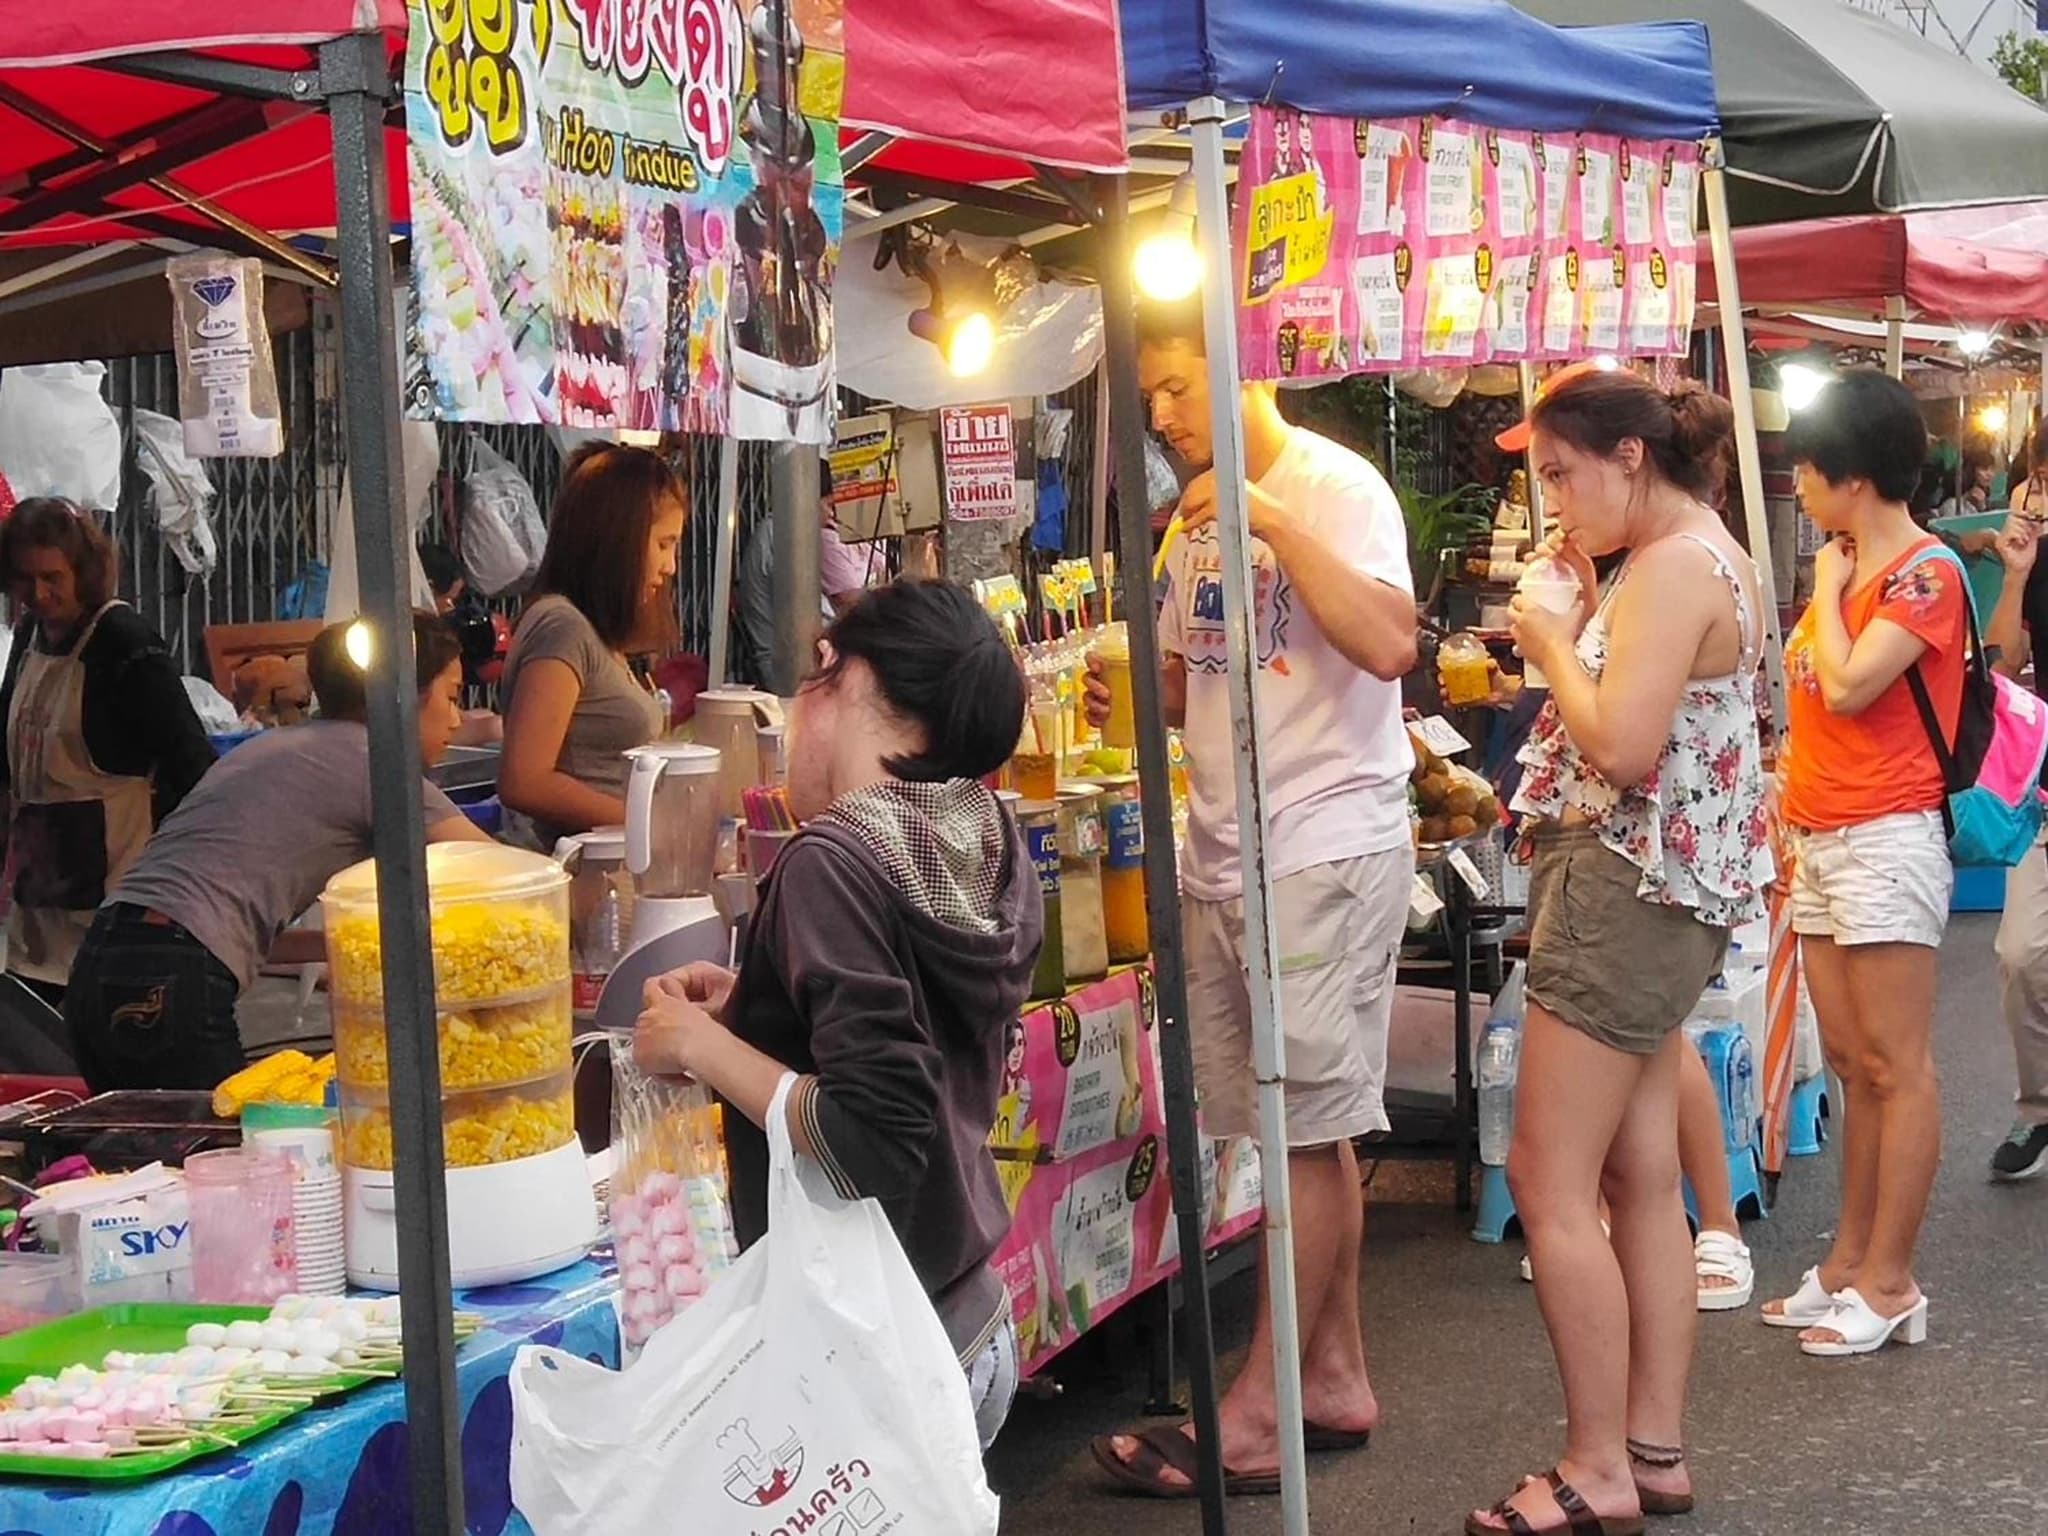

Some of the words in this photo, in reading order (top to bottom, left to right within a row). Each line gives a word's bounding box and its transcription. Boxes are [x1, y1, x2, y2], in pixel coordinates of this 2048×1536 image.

[1055, 1004, 1075, 1038] 20
[1134, 1142, 1155, 1174] 25
[121, 1220, 189, 1257] SKY
